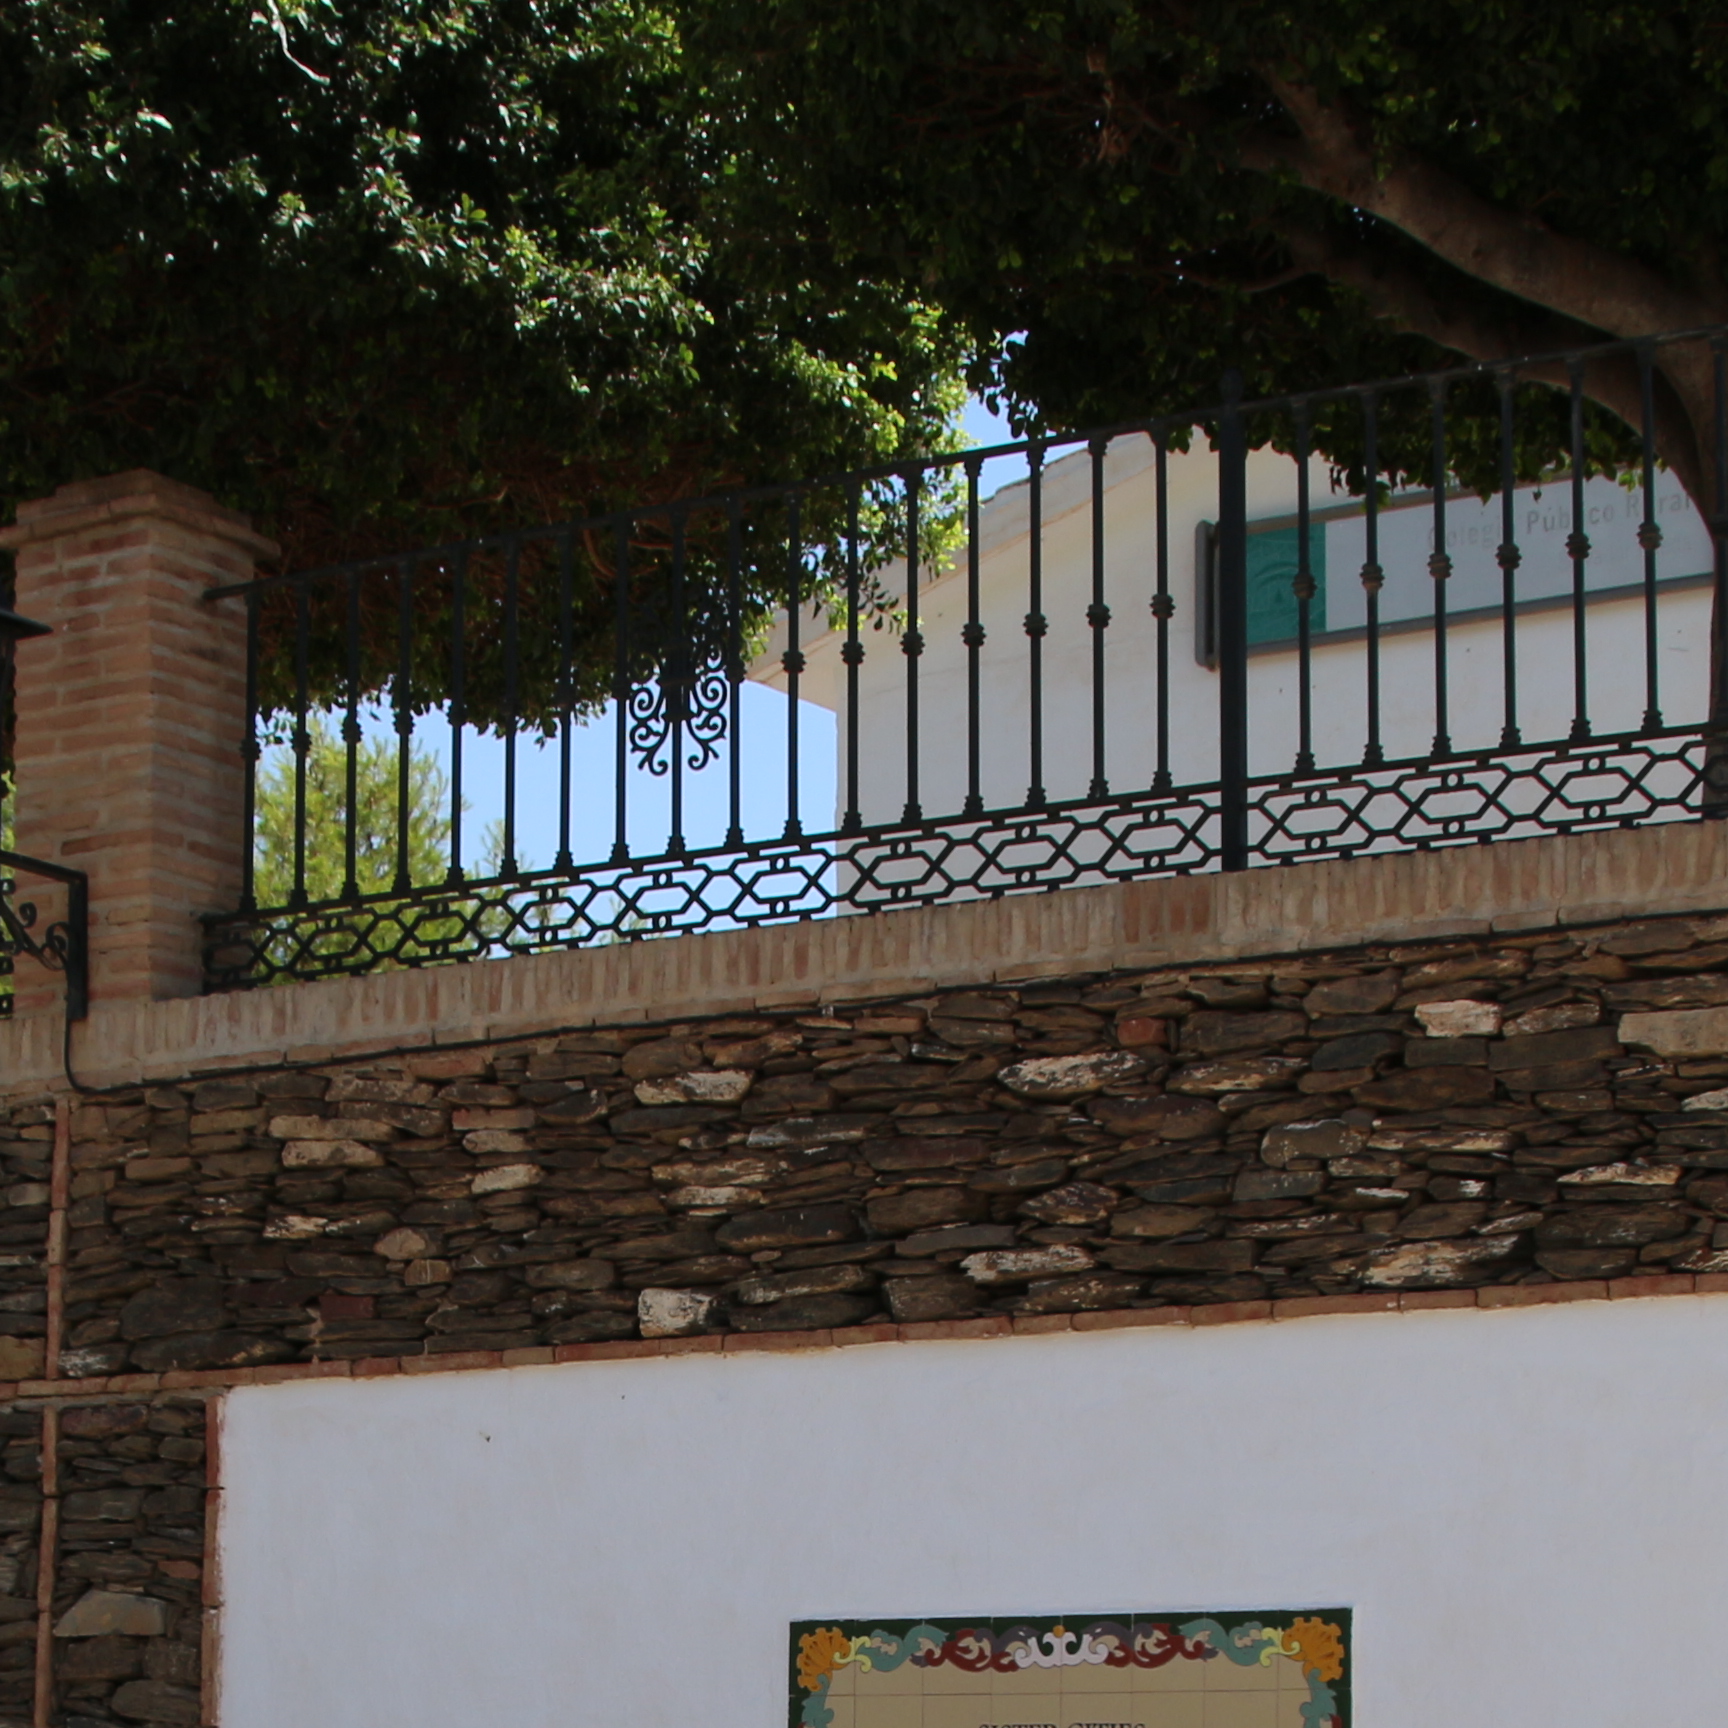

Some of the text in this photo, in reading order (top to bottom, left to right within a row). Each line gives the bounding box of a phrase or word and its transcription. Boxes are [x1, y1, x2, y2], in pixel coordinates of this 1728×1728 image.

[1427, 514, 1514, 551] Colegi
[1526, 503, 1615, 535] Púbco
[1626, 488, 1692, 519] Rral
